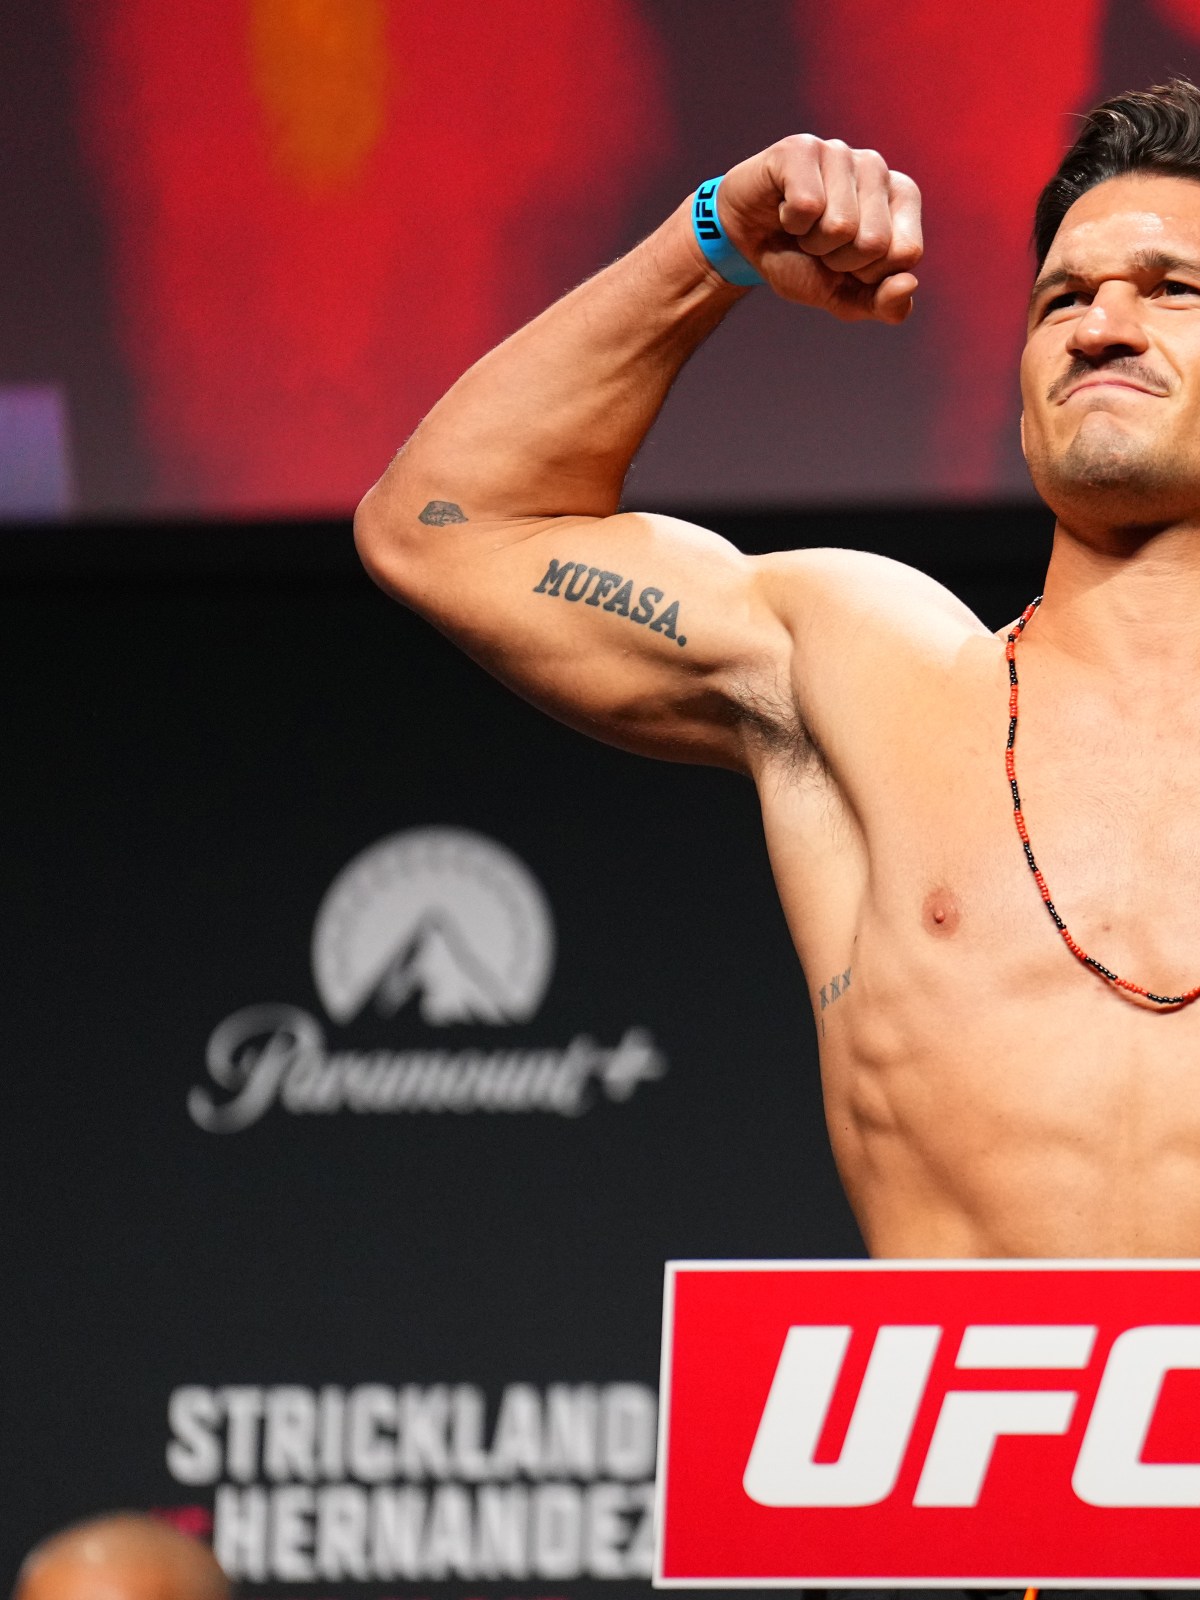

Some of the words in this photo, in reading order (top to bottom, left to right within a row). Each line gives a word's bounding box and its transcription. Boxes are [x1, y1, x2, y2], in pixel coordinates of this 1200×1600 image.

[695, 184, 722, 240] UFC
[533, 558, 687, 647] MUFASA.
[166, 1382, 658, 1485] STRICKLAND
